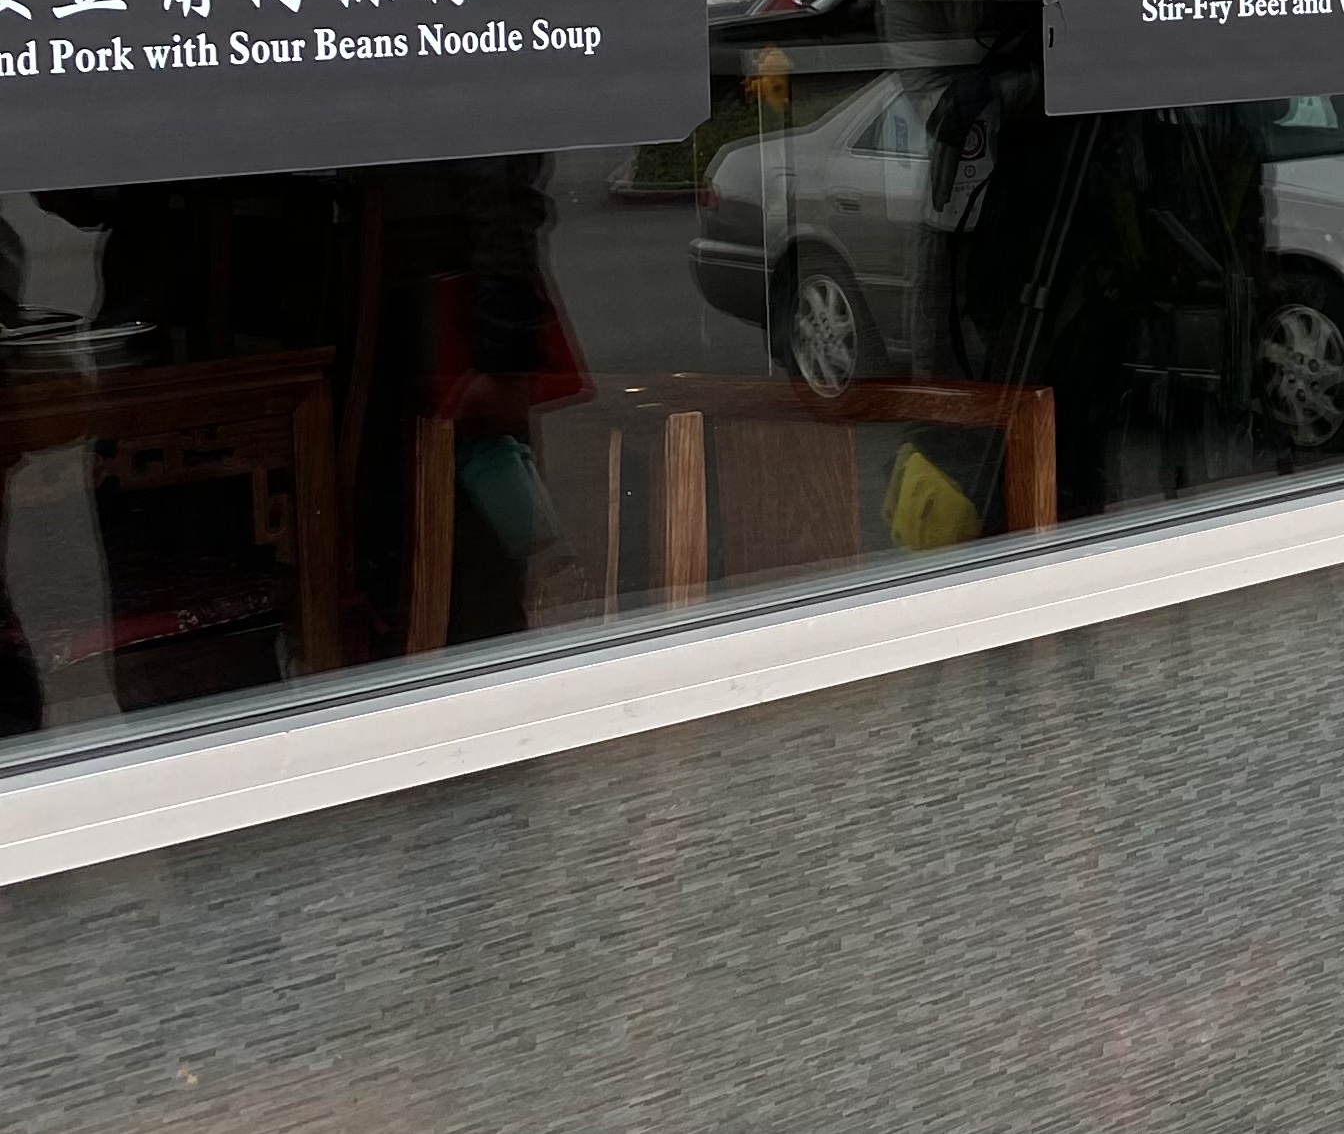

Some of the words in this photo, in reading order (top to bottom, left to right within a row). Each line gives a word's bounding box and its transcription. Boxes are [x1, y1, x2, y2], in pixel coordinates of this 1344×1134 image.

[49, 38, 136, 76] Pork
[145, 33, 220, 69] with
[228, 29, 306, 65] Sour
[314, 26, 408, 61] Beans
[417, 20, 523, 56] Noodle
[532, 17, 602, 55] Soup
